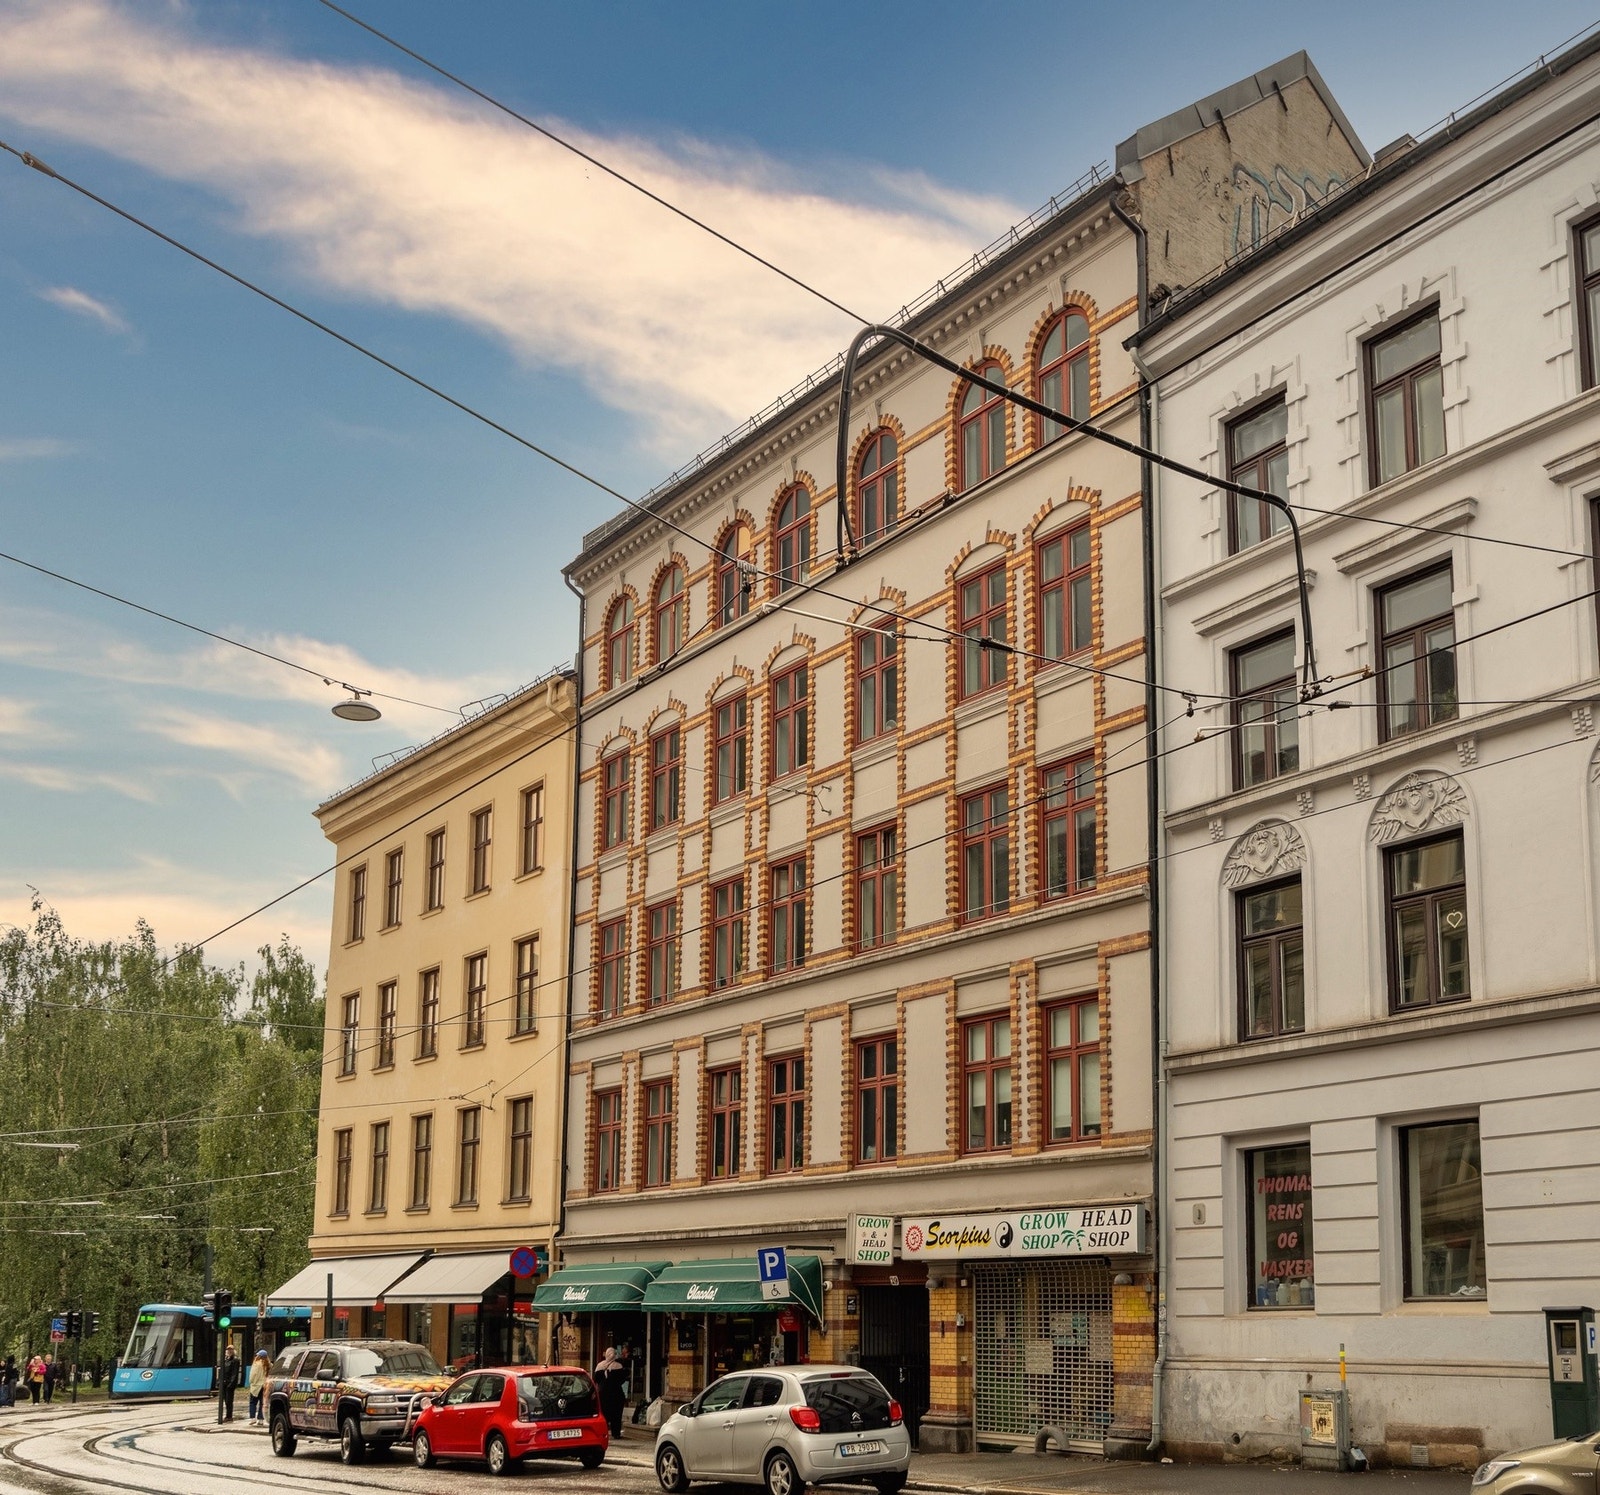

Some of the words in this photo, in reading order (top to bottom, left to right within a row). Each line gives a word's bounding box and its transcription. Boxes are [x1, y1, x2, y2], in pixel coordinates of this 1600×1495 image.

[1080, 1208, 1132, 1228] HEAD
[1267, 1203, 1304, 1221] RENS
[857, 1217, 891, 1229] GROW
[1020, 1212, 1069, 1231] GROW
[862, 1239, 886, 1248] HEAD
[870, 1230, 877, 1239] &
[925, 1221, 992, 1253] Scorpius
[1021, 1233, 1060, 1250] SHOP
[1087, 1230, 1130, 1248] SHOP
[1277, 1231, 1298, 1249] OG
[857, 1249, 890, 1262] SHOP
[764, 1252, 780, 1278] P
[1589, 1327, 1596, 1349] P
